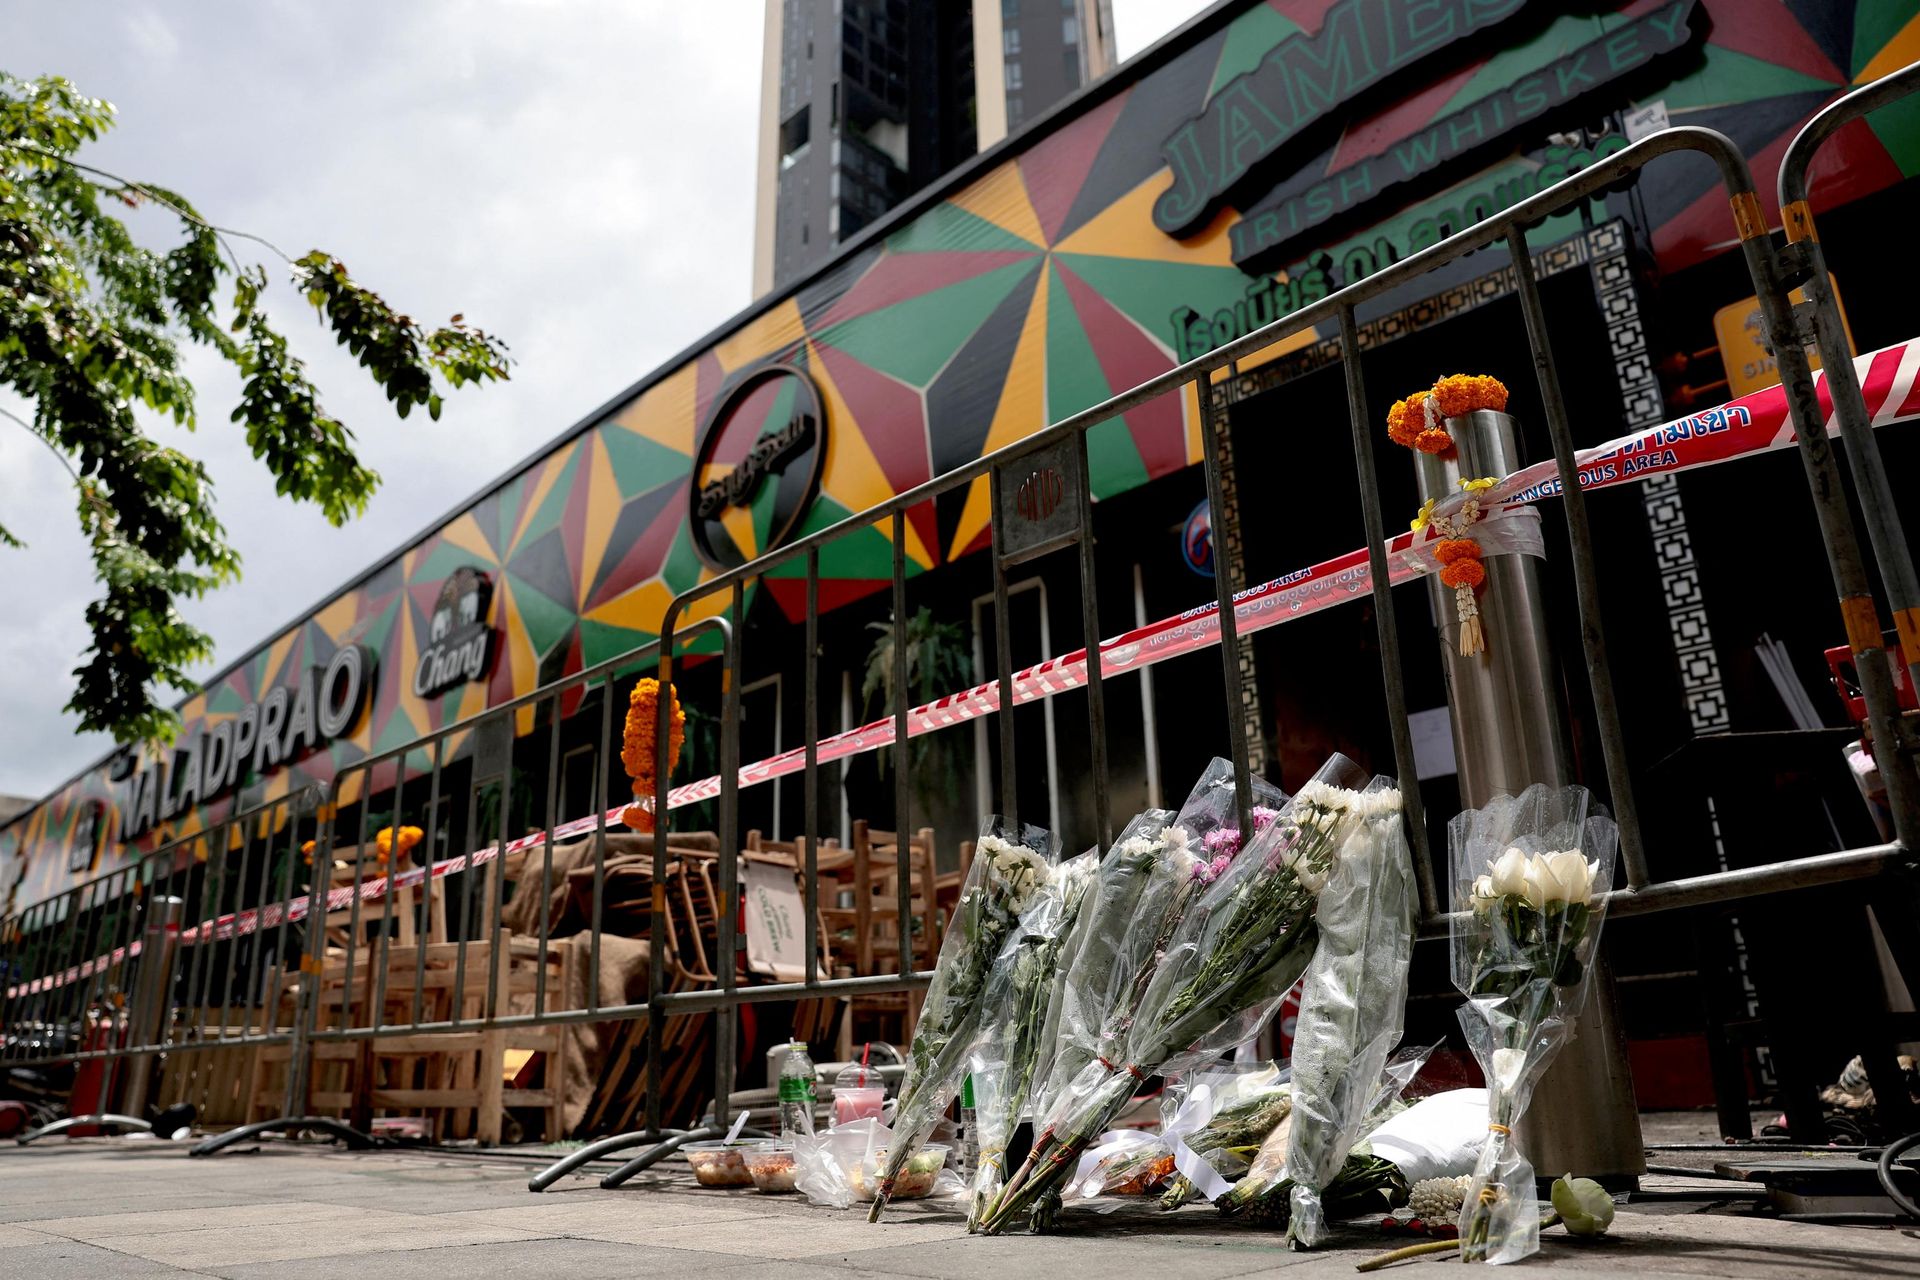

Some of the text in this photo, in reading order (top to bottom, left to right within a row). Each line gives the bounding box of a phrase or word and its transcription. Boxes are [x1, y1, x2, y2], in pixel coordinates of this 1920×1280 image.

[1161, 0, 1518, 226] JAME
[1235, 5, 1682, 255] IRISH WHISKEY
[1502, 449, 1678, 504] ANGEOUS AREA
[1181, 583, 1268, 620] DANGOUS
[415, 632, 488, 696] Chang
